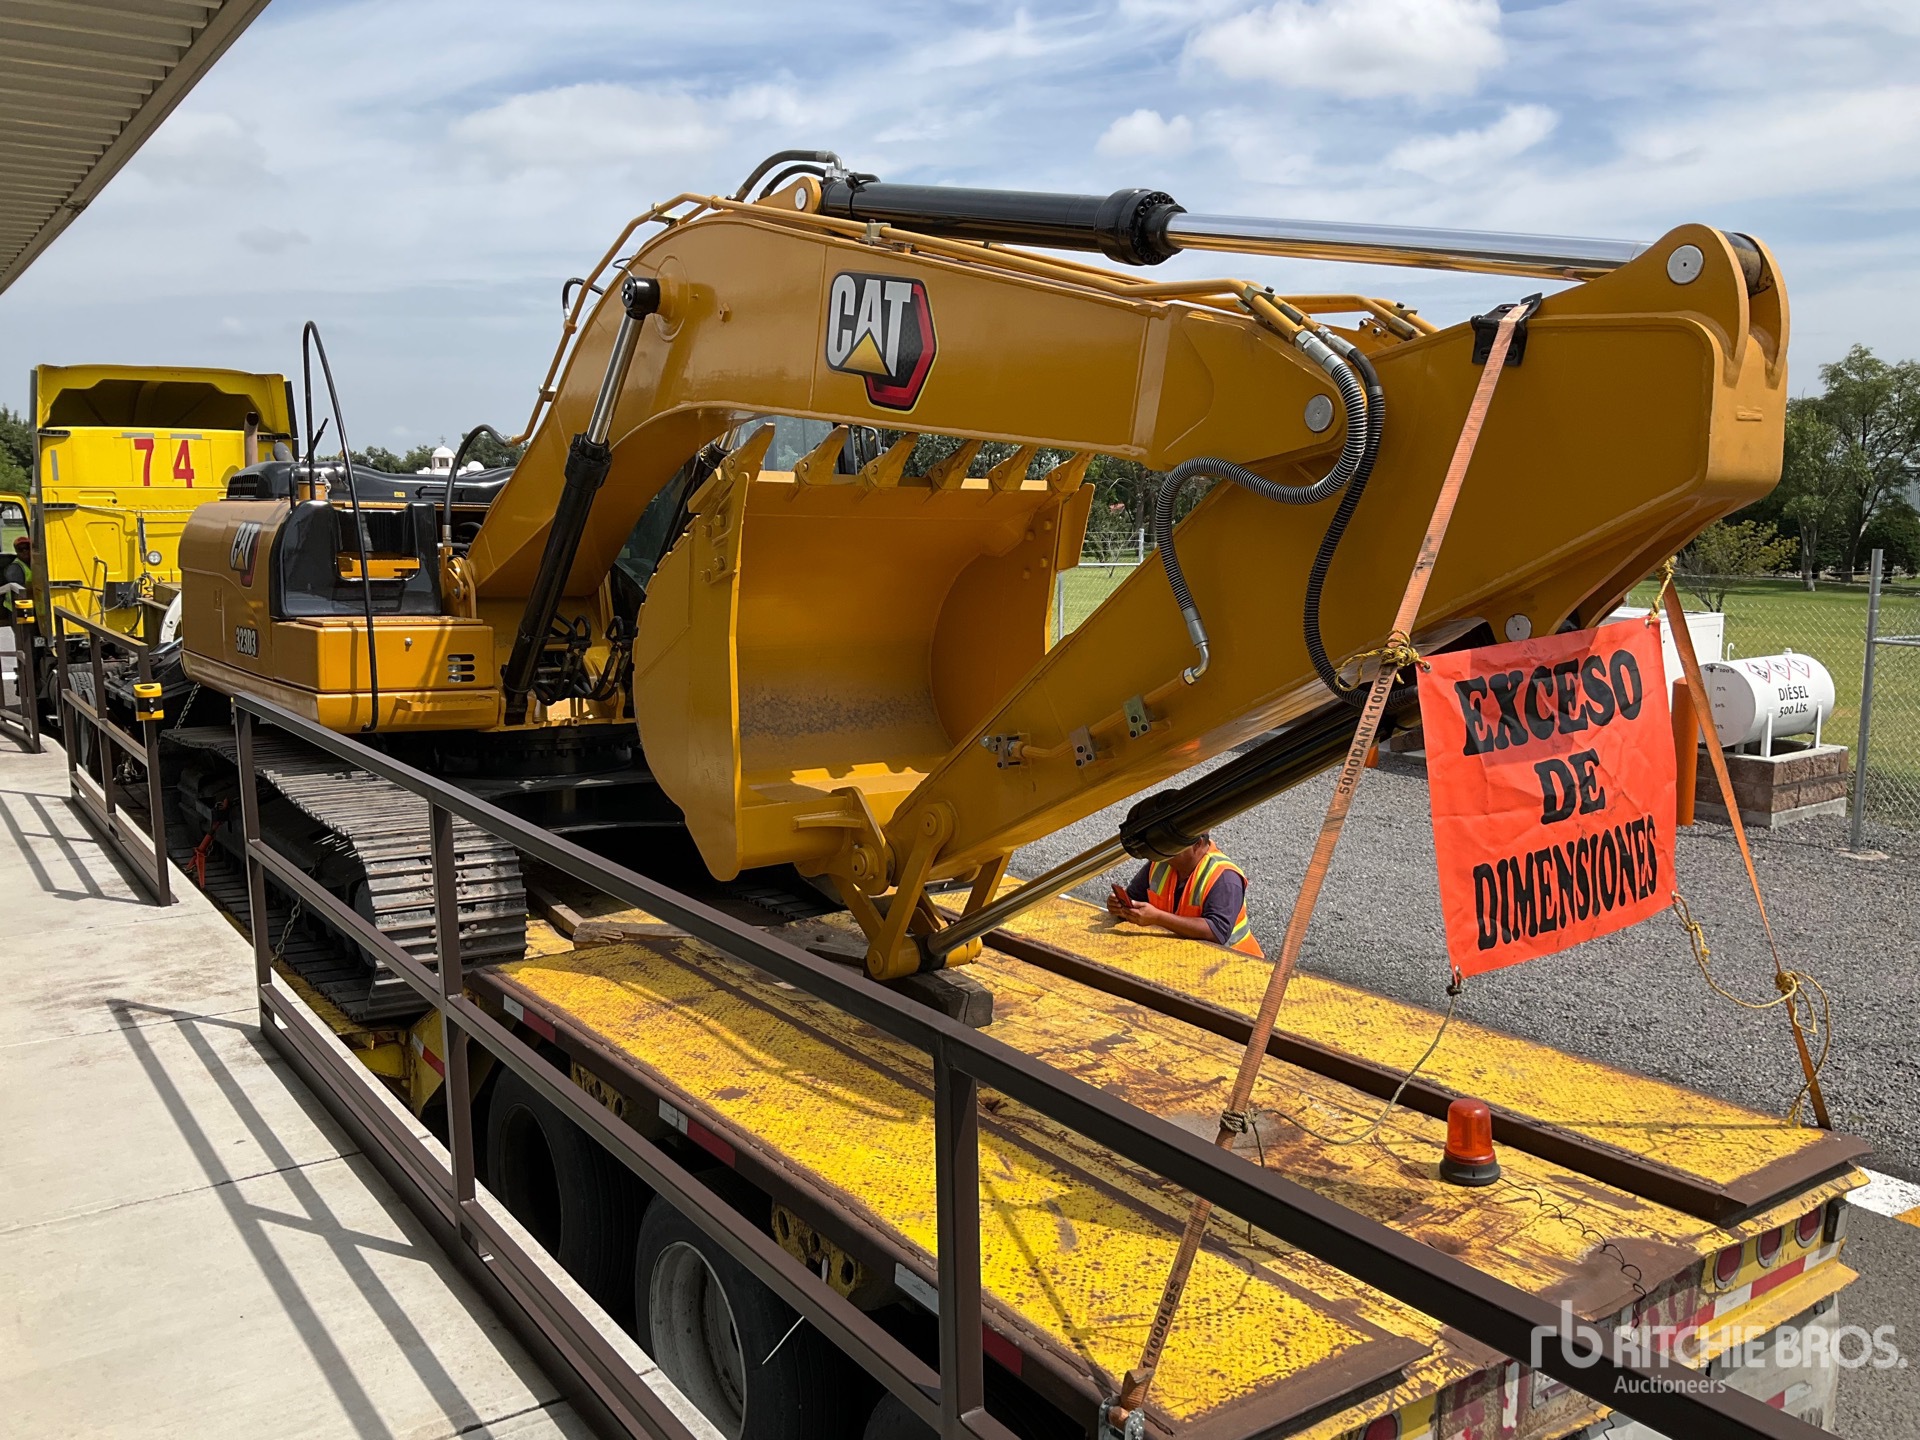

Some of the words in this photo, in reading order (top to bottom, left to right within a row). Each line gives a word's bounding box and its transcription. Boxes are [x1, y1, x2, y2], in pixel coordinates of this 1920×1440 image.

[827, 274, 912, 377] CAT
[230, 522, 262, 570] CAT
[1454, 649, 1643, 756] EXCESO
[1778, 684, 1809, 701] DIÉSEL
[1778, 705, 1795, 718] 500
[1795, 702, 1809, 714] Lts.
[1533, 748, 1606, 825] DE
[1473, 814, 1657, 950] DIMENSIONES
[1142, 1280, 1180, 1368] 11000LBS
